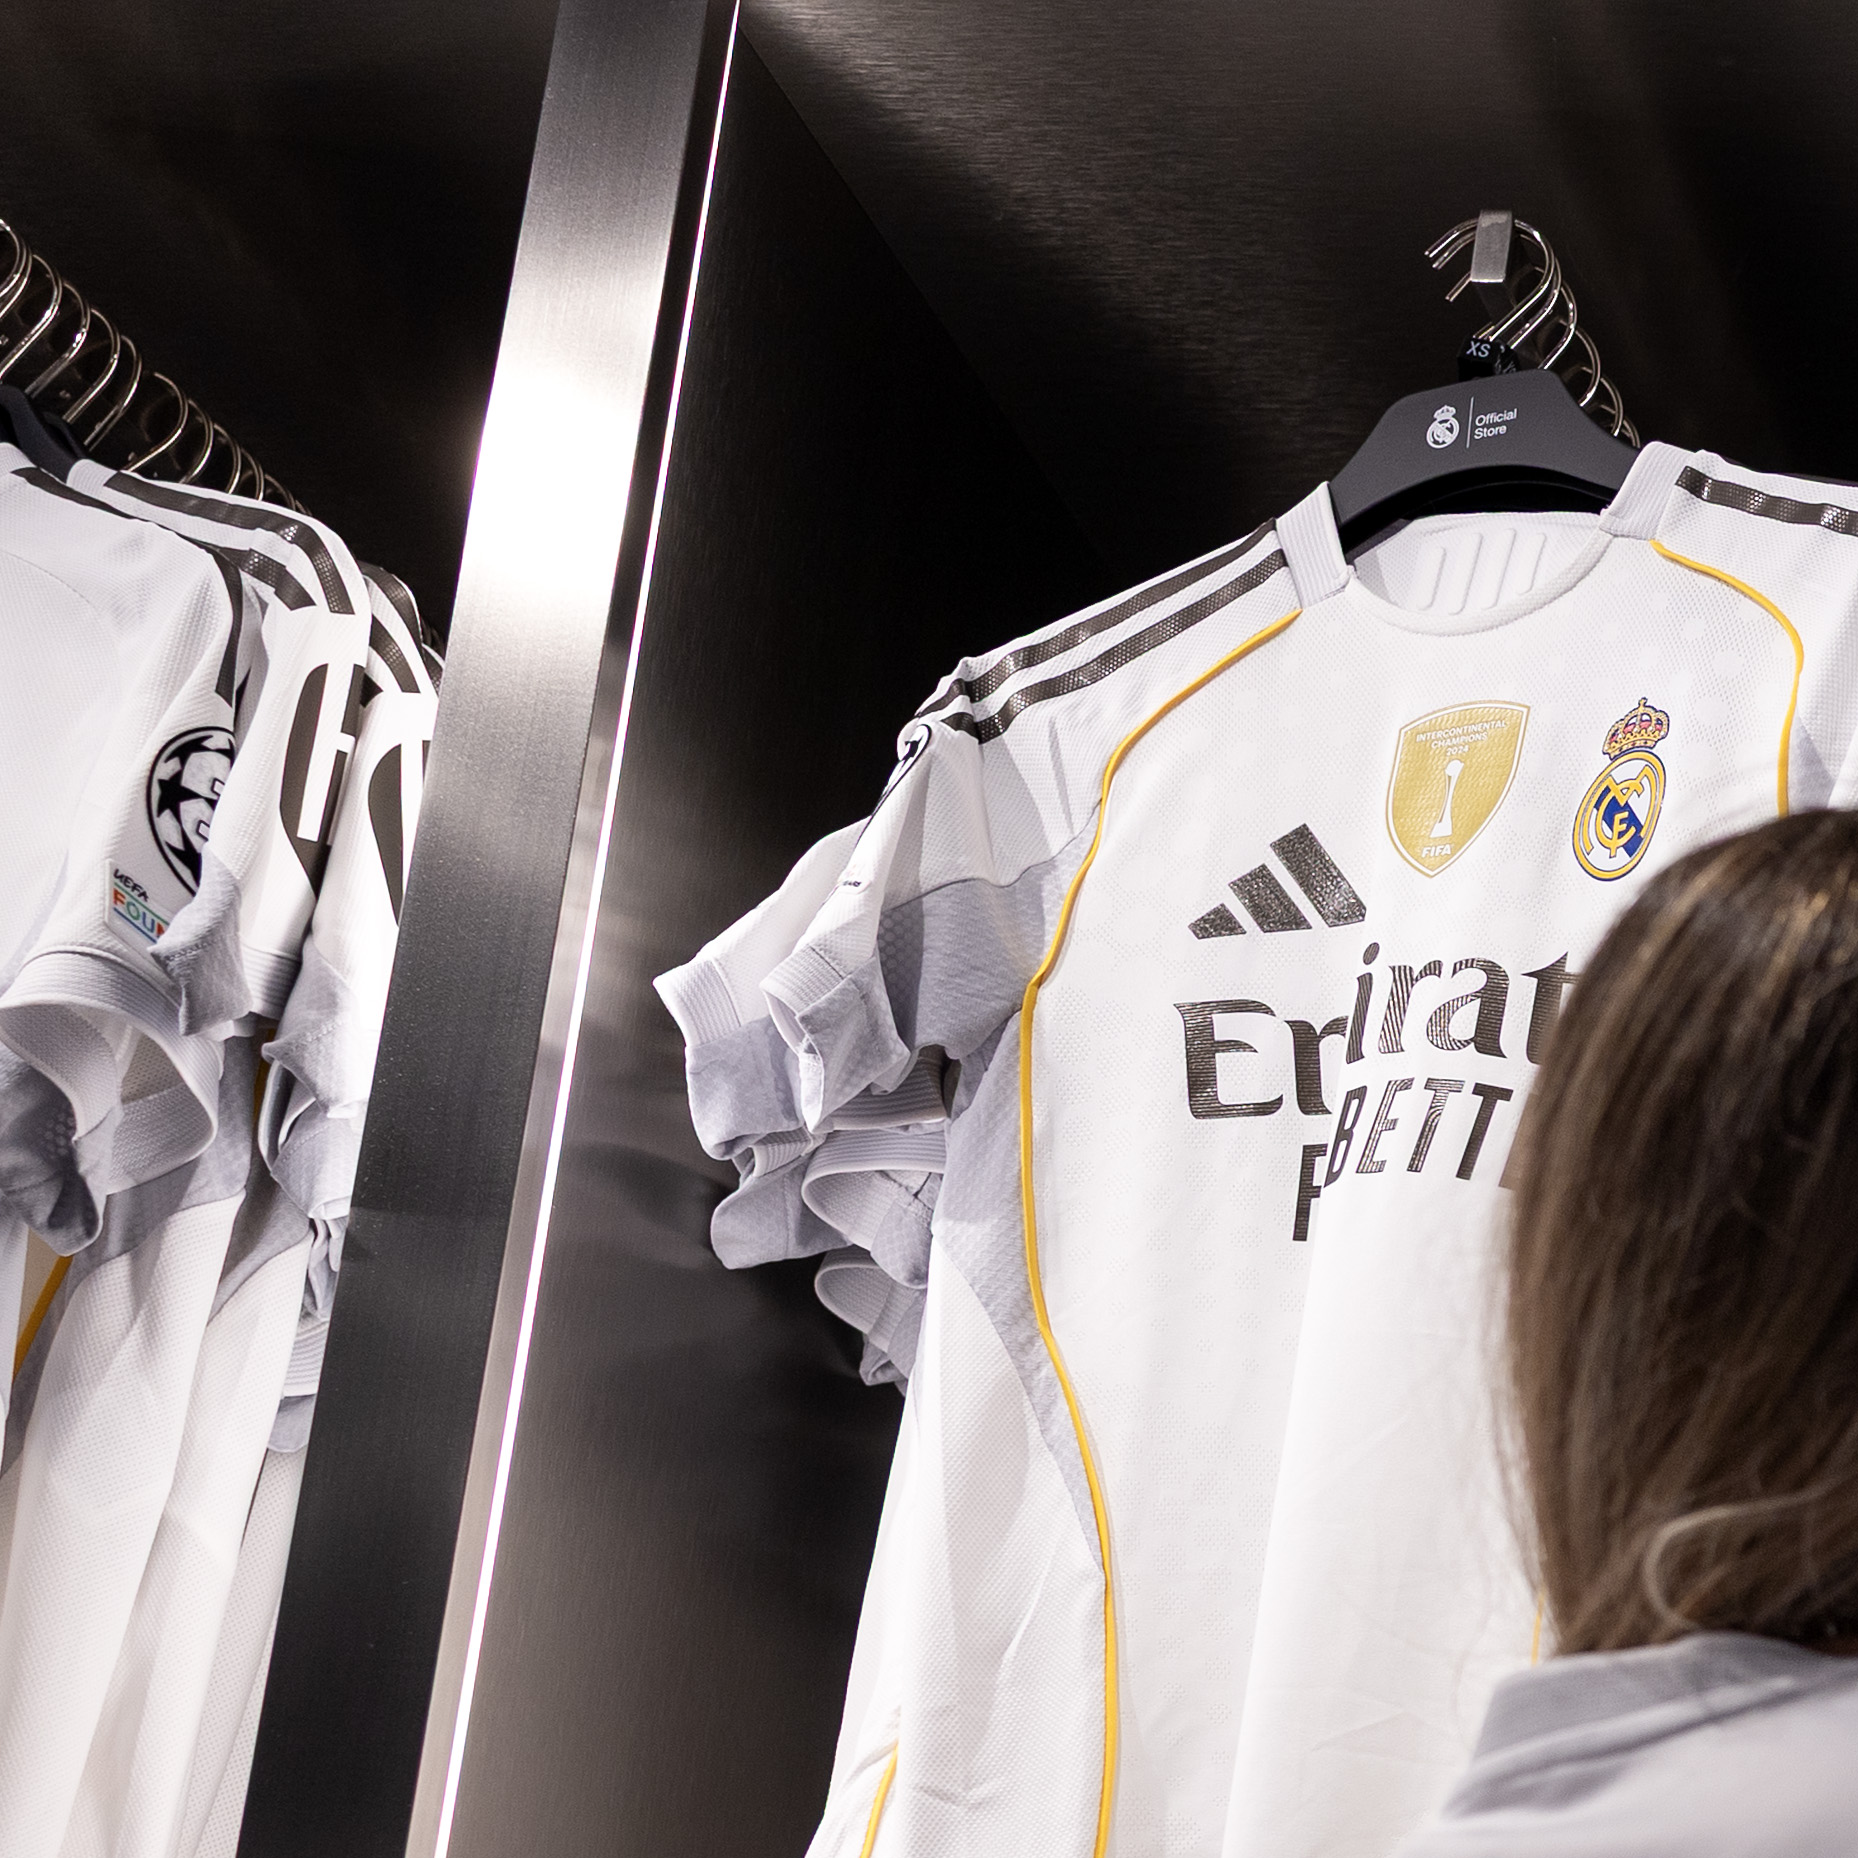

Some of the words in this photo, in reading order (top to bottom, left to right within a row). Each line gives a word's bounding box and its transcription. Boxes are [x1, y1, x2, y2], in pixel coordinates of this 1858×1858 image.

[1466, 340, 1491, 358] XS
[1475, 408, 1518, 427] Official
[1473, 425, 1507, 440] Store
[1415, 719, 1509, 743] INTERCONTINENTAL
[1430, 731, 1488, 750] CHAMPIONS
[1445, 744, 1470, 757] 2024
[1420, 843, 1452, 859] FIFA
[112, 868, 150, 903] UEFA
[1323, 1077, 1530, 1191] BETT
